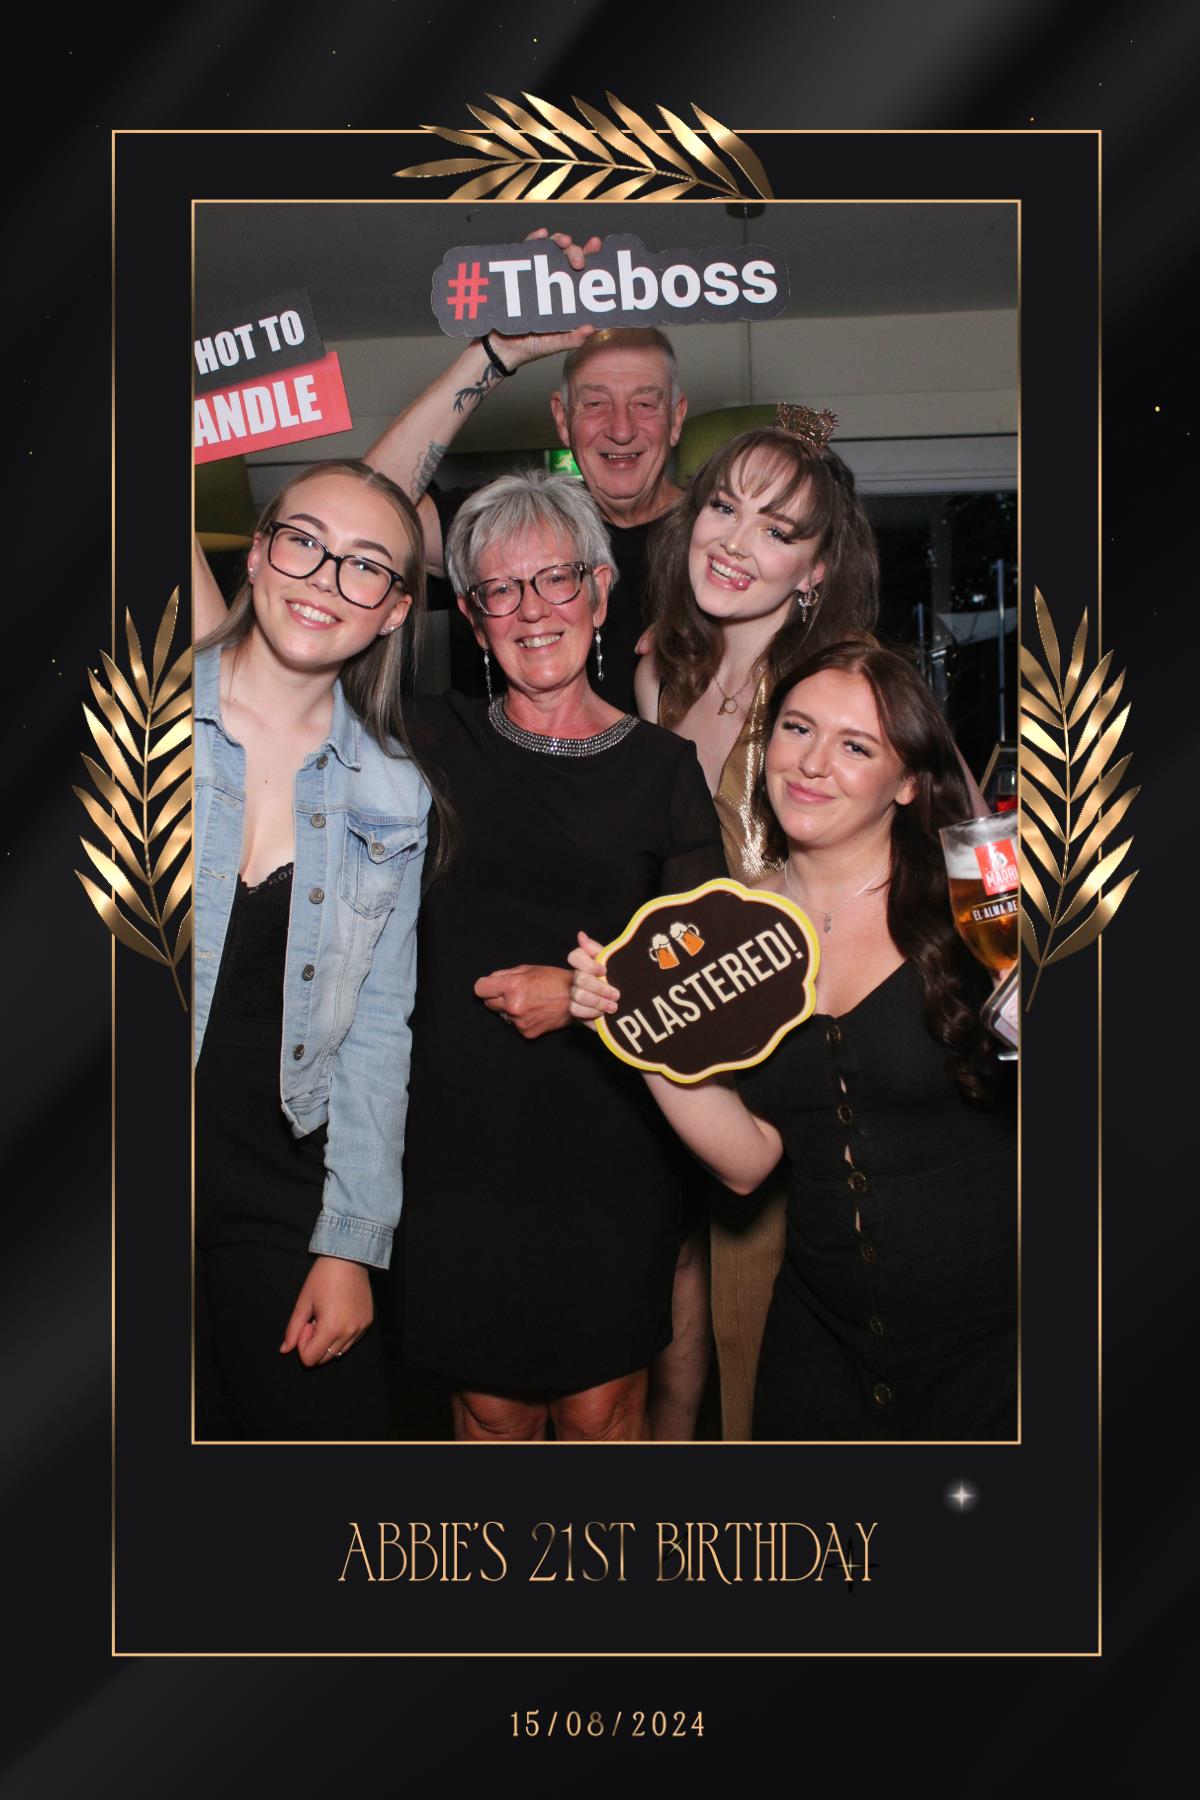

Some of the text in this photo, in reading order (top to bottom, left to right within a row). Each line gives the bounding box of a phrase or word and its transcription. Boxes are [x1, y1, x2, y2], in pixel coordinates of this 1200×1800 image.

[447, 250, 778, 320] #Theboss
[194, 310, 305, 375] HOT TO
[972, 900, 1018, 921] EL ALMA DE
[615, 922, 804, 1054] PLASTERED!
